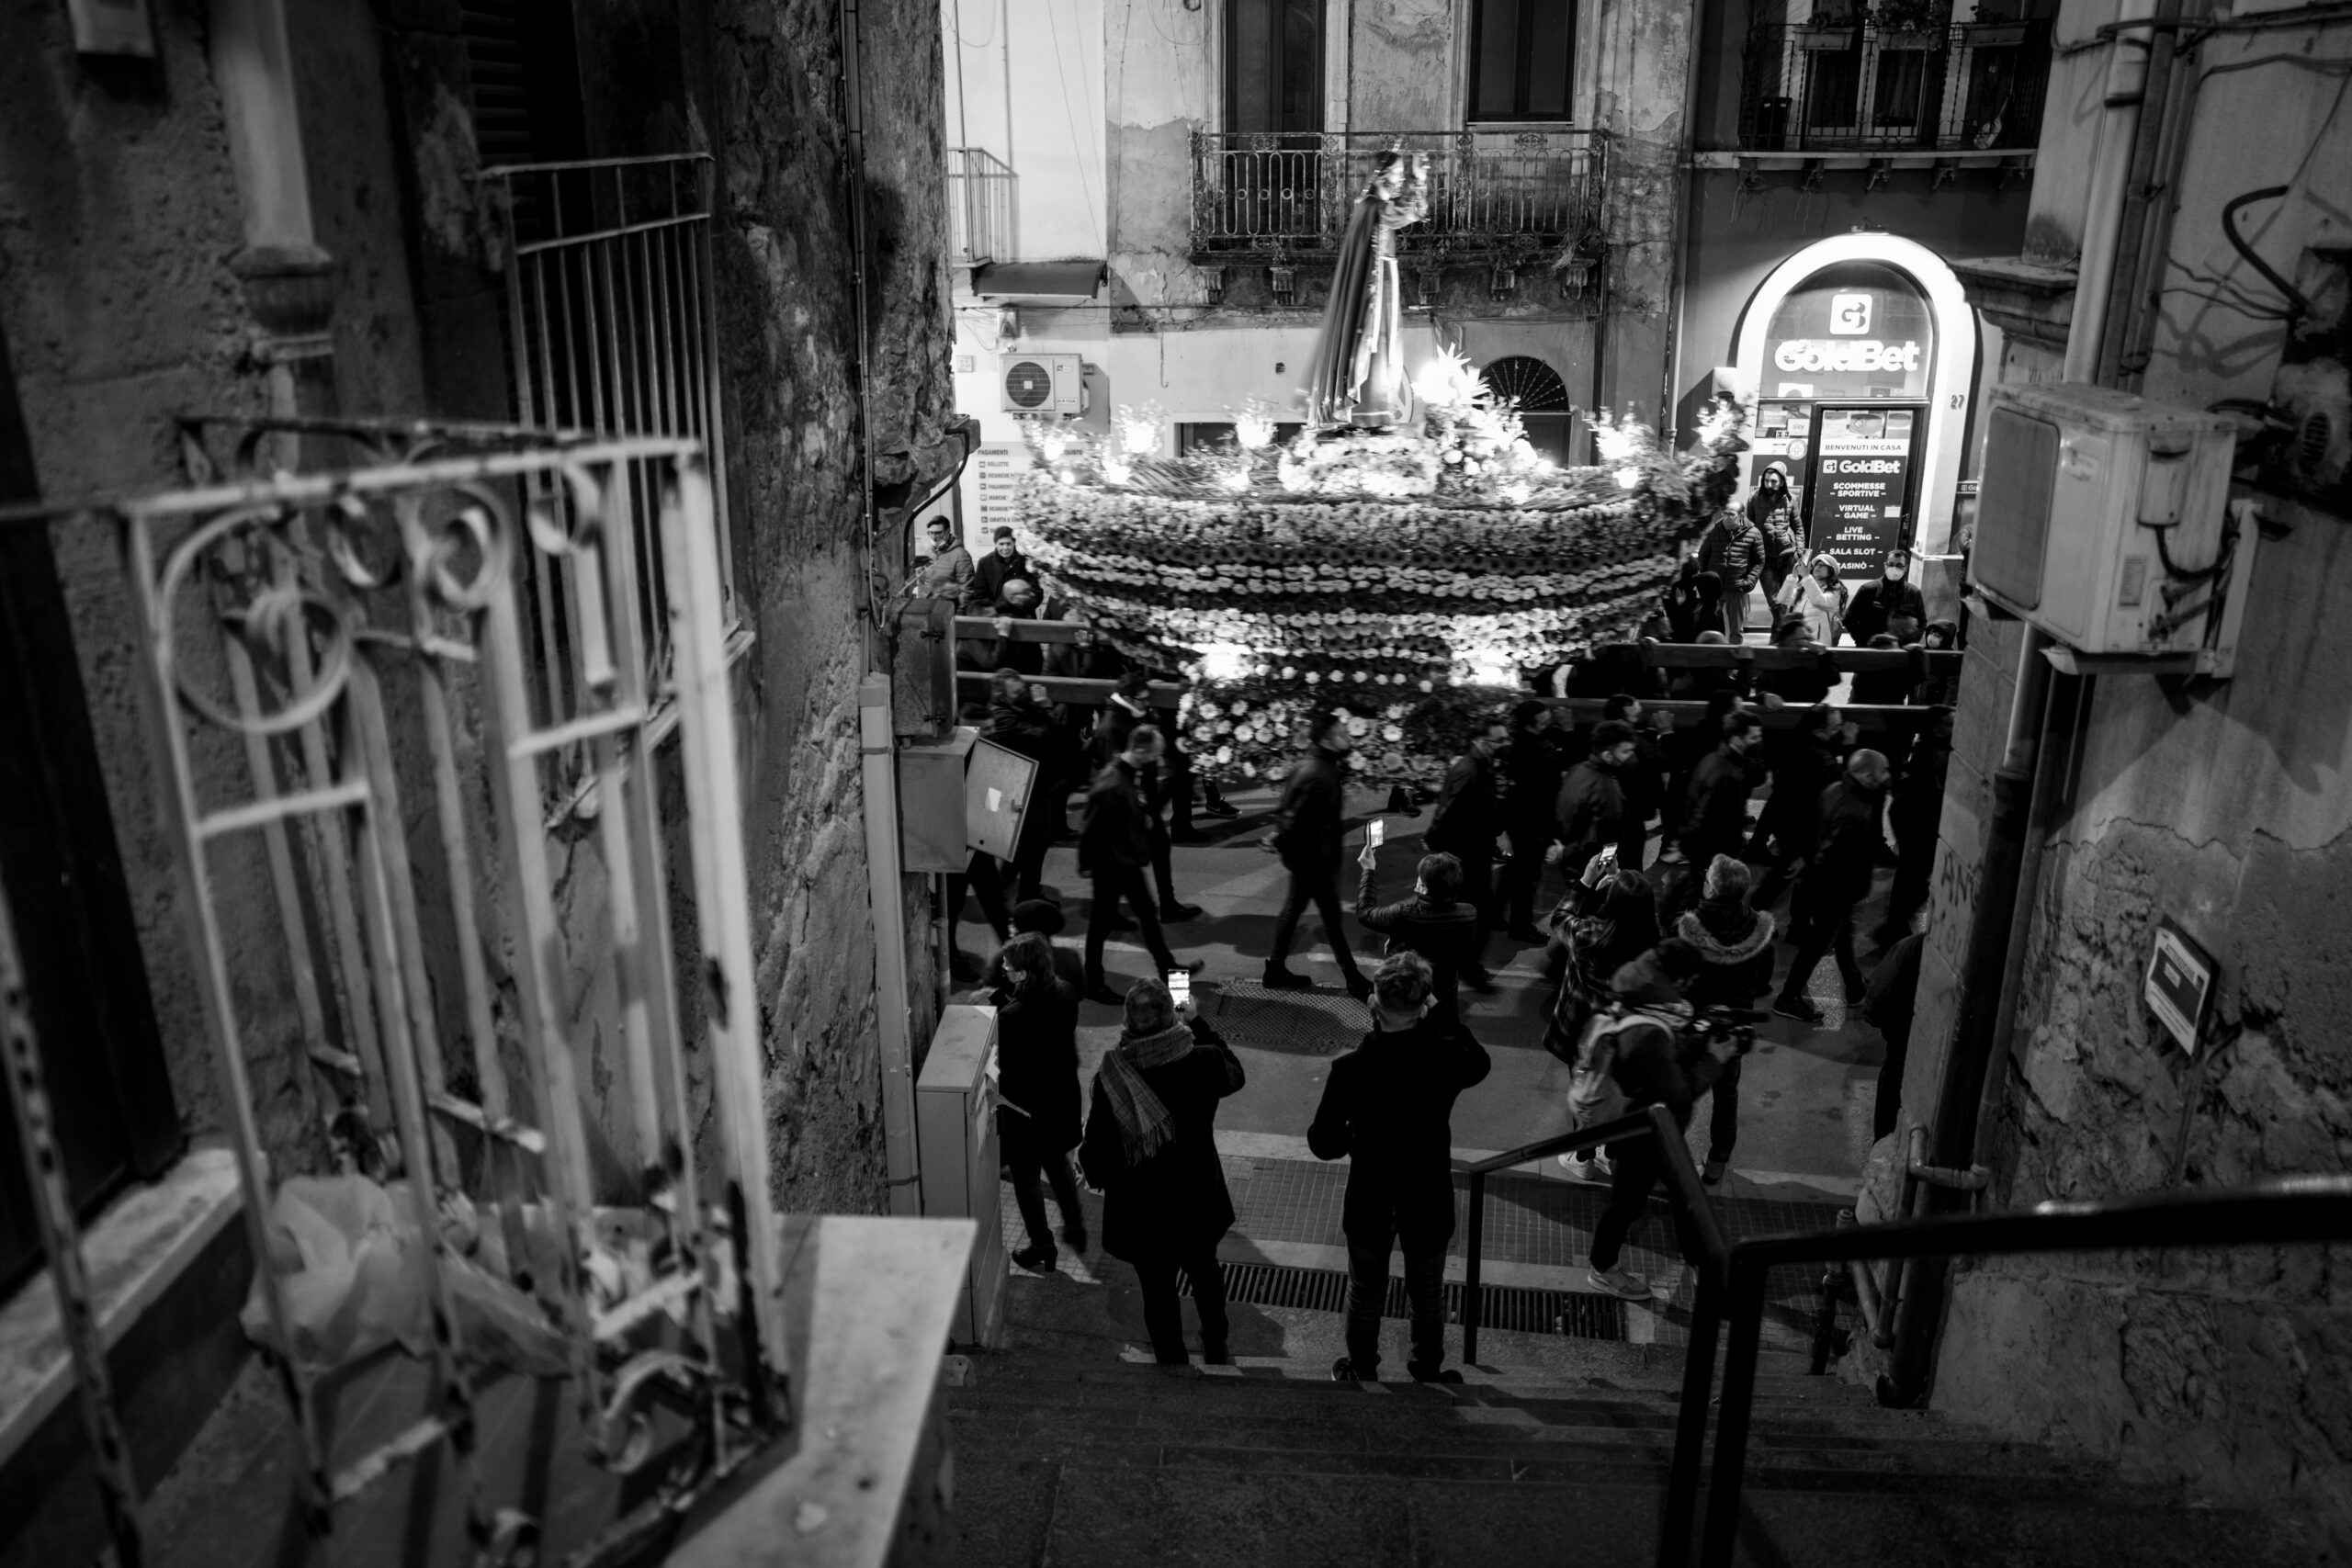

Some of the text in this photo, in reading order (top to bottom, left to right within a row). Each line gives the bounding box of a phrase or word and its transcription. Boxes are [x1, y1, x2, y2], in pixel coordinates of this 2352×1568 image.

[1775, 340, 1919, 371] GoldBet
[1951, 394, 1965, 410] 27
[1839, 460, 1901, 473] GoldBet
